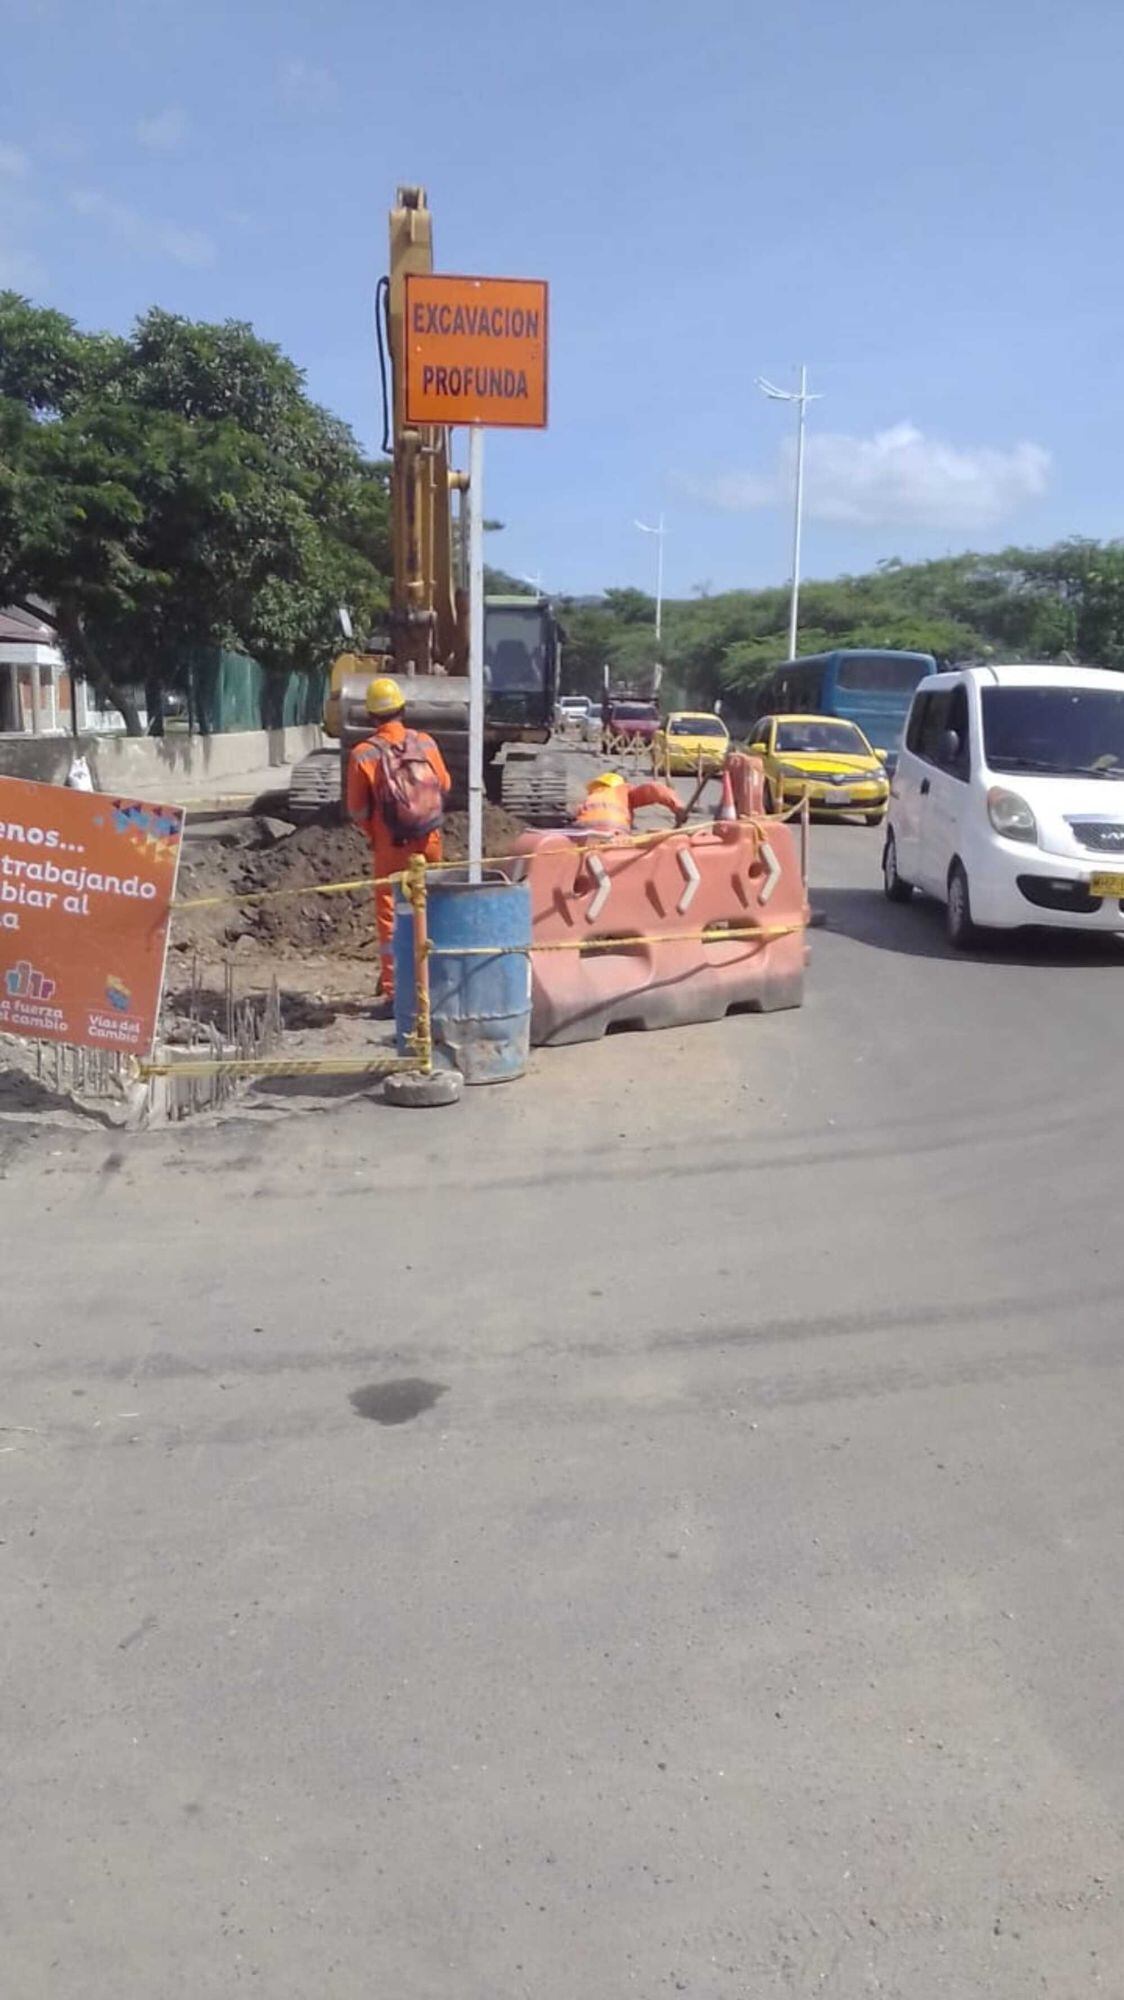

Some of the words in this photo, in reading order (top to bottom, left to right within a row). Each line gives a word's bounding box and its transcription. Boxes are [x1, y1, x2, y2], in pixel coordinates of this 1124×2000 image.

[413, 302, 539, 338] EXCAVACION
[423, 365, 529, 399] PROFUNDA
[2, 854, 157, 899] trabajando
[63, 894, 90, 915] al
[14, 1000, 63, 1019] fuerza
[12, 1012, 68, 1031] cambio
[88, 1026, 139, 1043] Cambio
